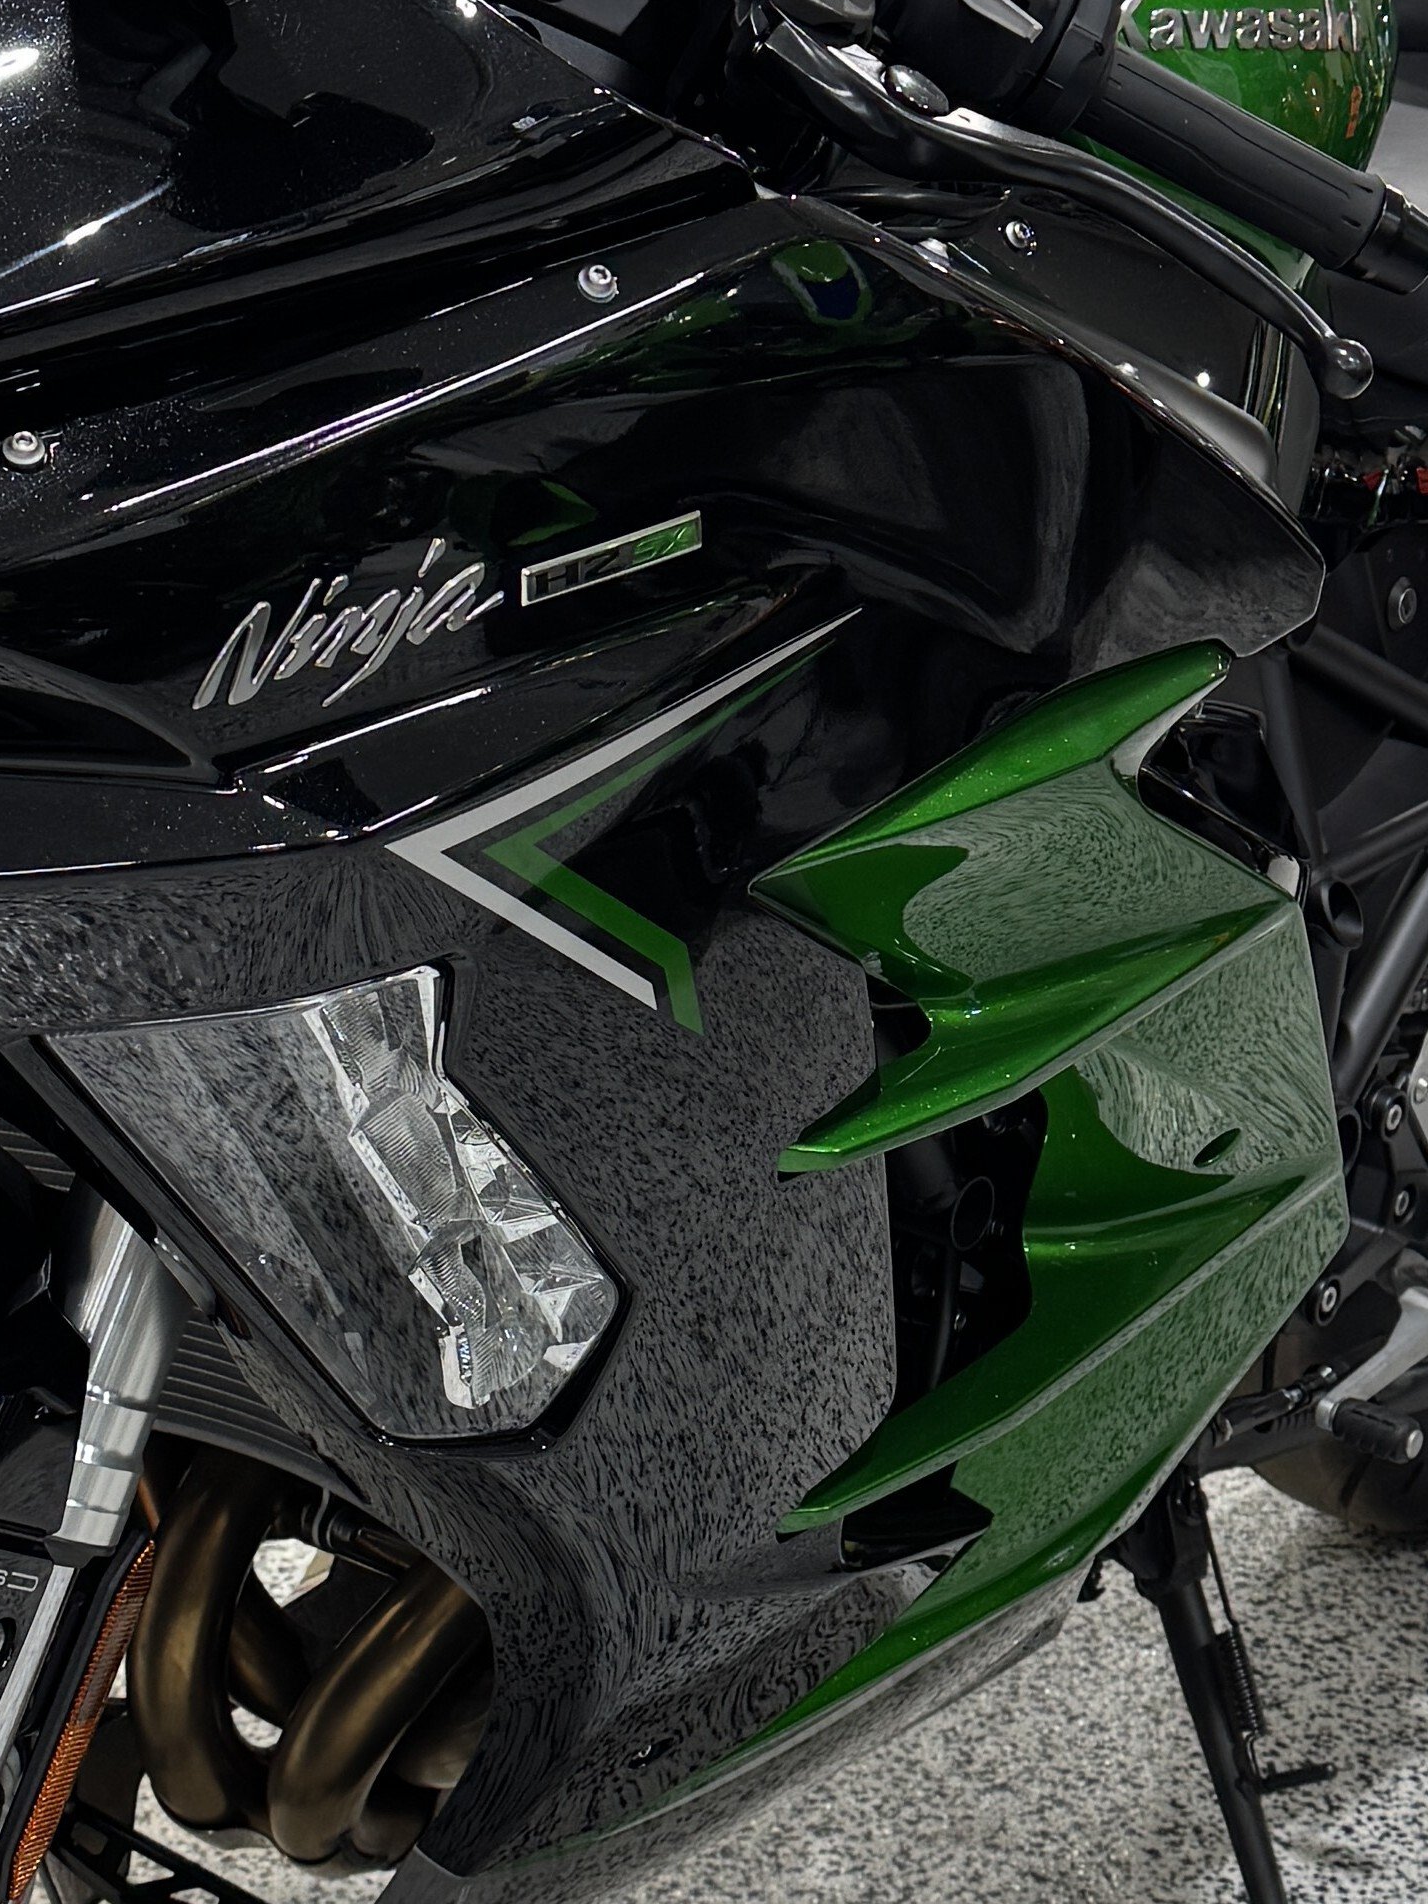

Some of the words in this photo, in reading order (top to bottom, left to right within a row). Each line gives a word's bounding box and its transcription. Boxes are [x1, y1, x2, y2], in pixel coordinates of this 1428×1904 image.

[192, 537, 505, 711] Ninja
[535, 545, 621, 595] H2
[634, 526, 689, 563] SX
